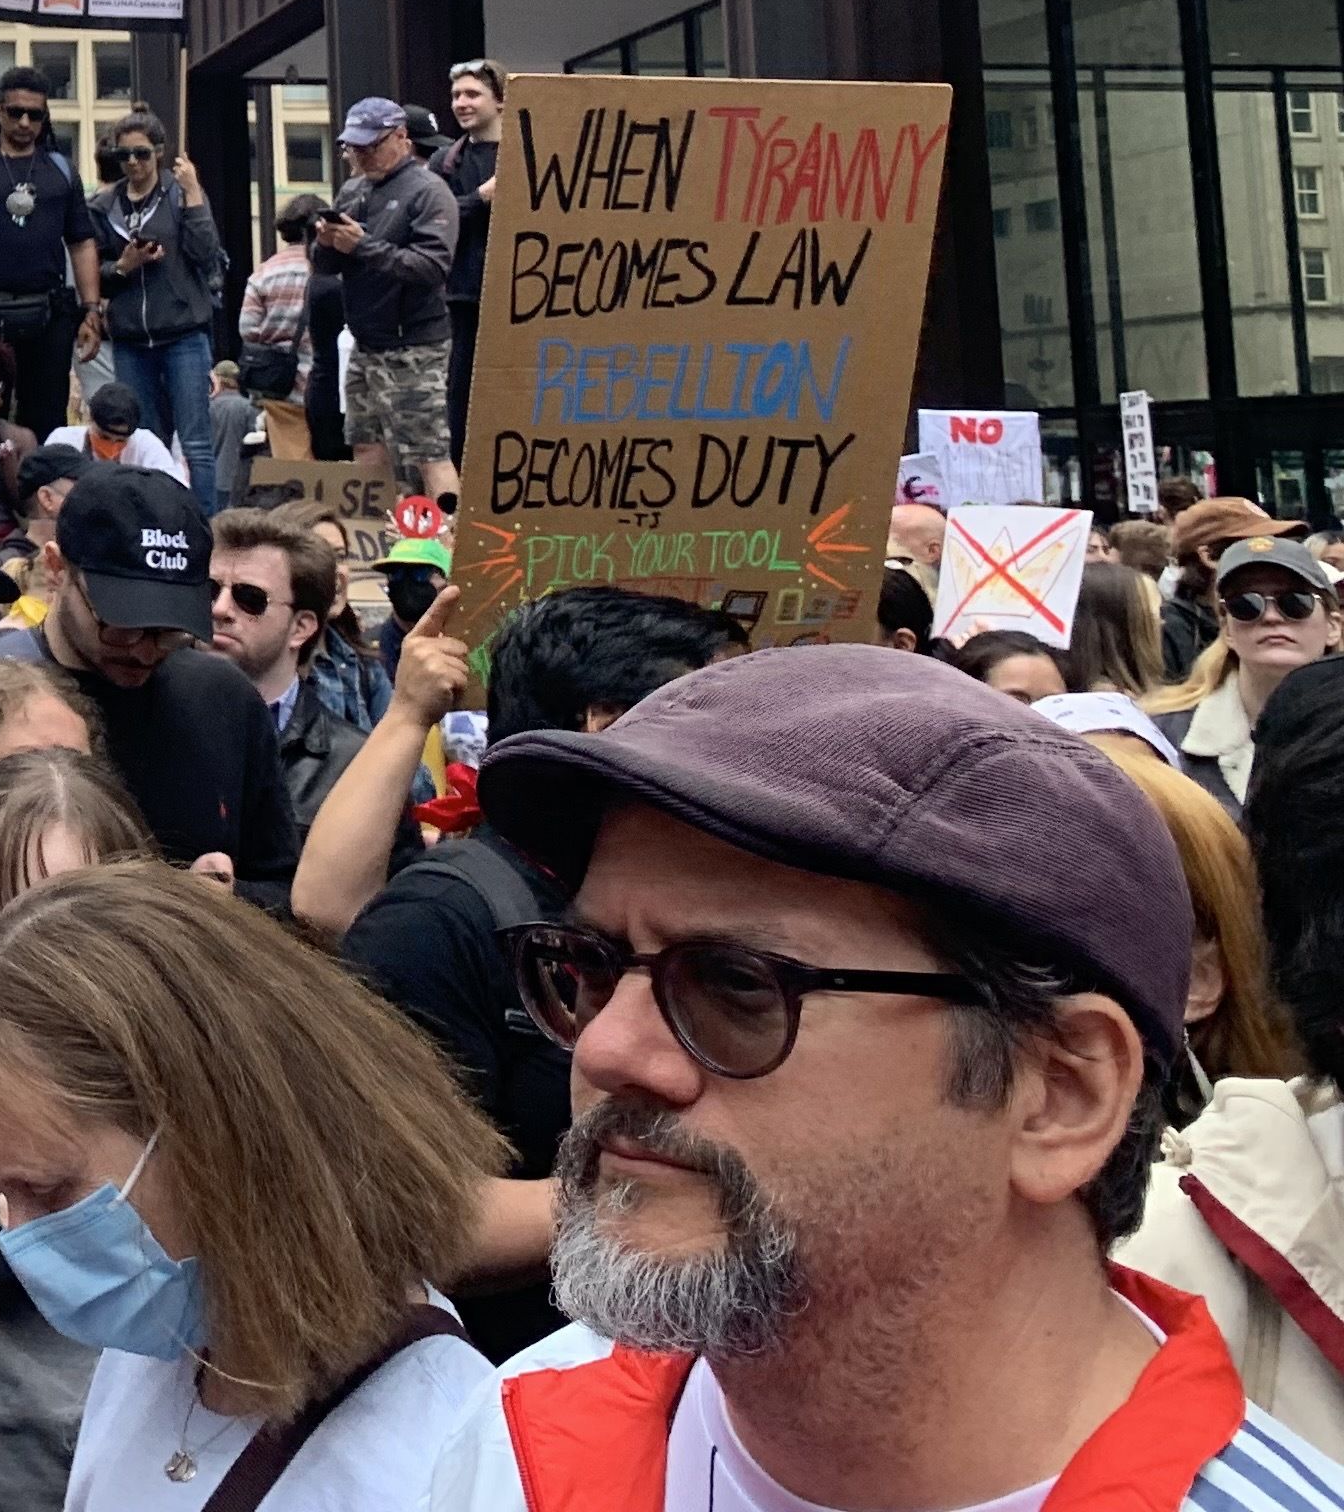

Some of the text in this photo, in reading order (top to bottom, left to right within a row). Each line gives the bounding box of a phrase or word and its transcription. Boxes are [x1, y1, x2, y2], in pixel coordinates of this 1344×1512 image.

[518, 106, 949, 226] WHEN TYRANNY
[510, 227, 873, 325] BECOMES LAW
[533, 335, 853, 426] REBELLION
[949, 415, 1004, 445] NO
[491, 430, 677, 515] BECOMES
[691, 433, 857, 515] DUTY
[140, 528, 190, 549] Block
[145, 549, 188, 571] Club
[523, 528, 802, 587] PICK YOUR TOOL
